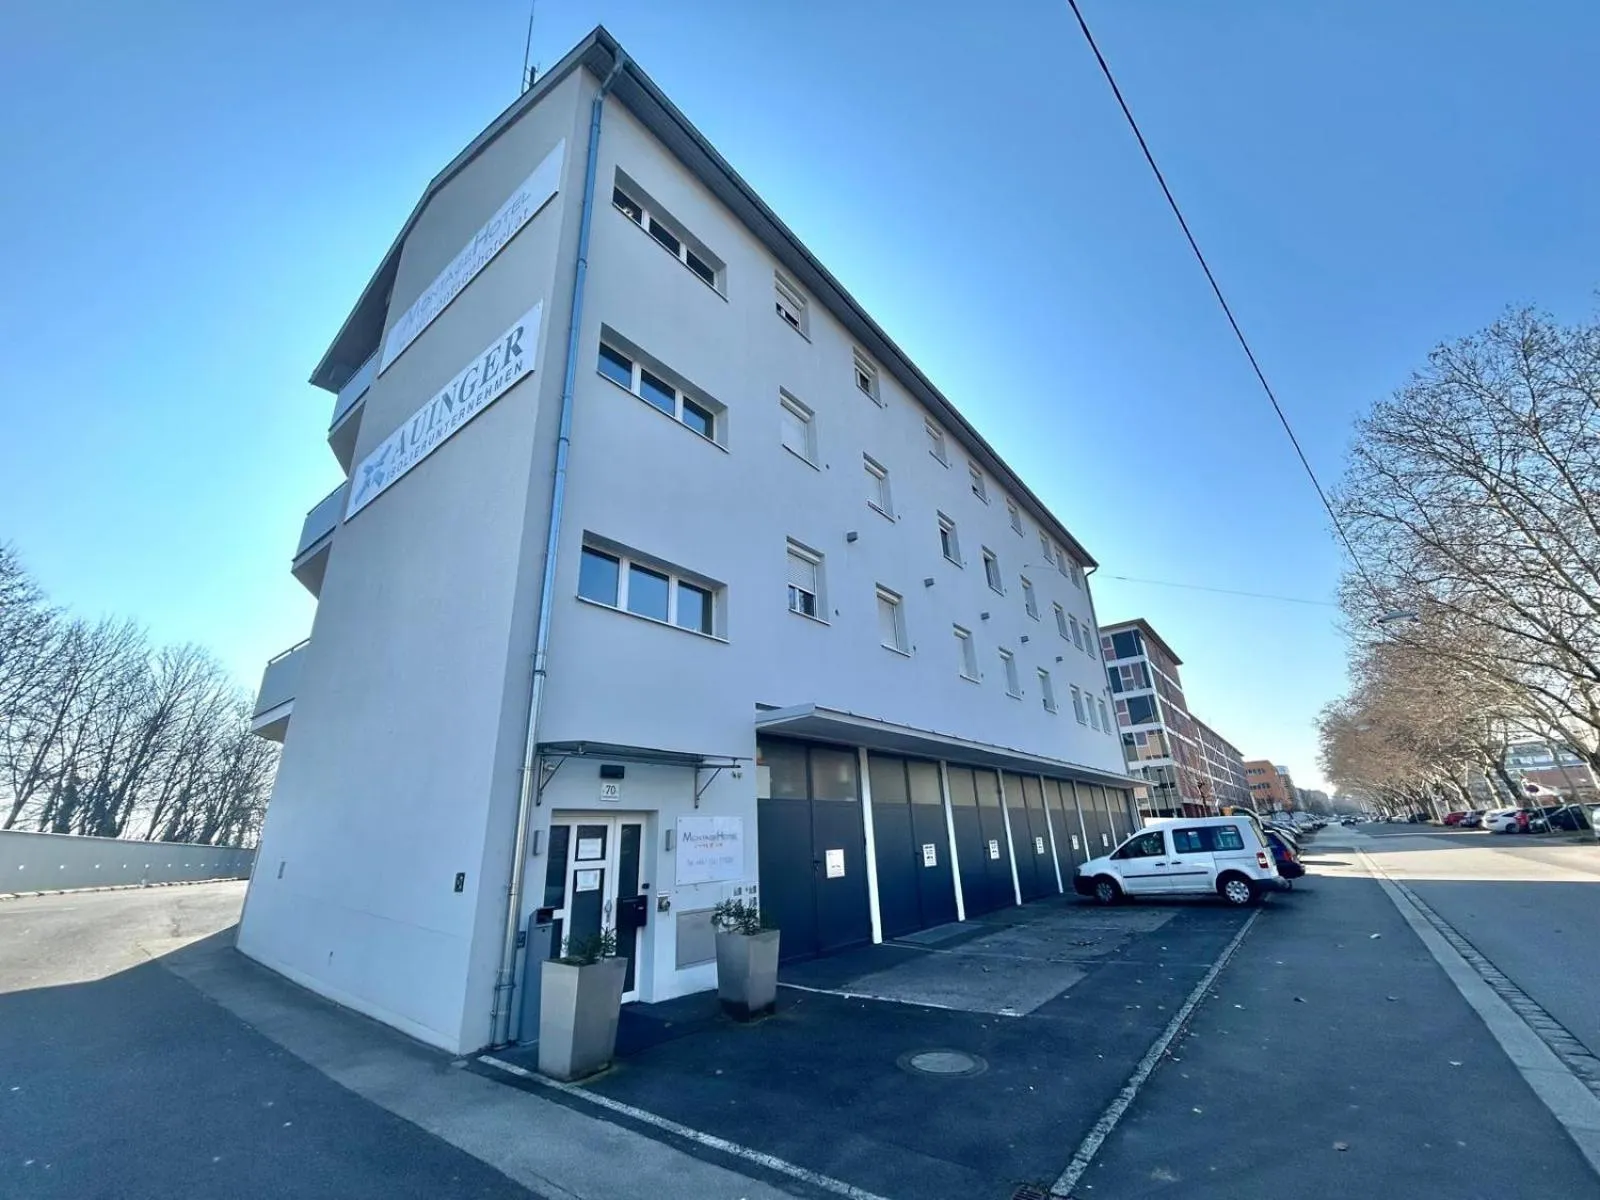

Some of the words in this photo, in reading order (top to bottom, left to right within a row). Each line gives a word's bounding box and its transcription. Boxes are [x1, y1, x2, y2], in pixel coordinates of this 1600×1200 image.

[386, 360, 523, 482] ISOLIERUNTERNEHMEN
[391, 325, 524, 462] AUINGER
[606, 785, 616, 795] 70
[682, 830, 738, 842] MONTAGEH
